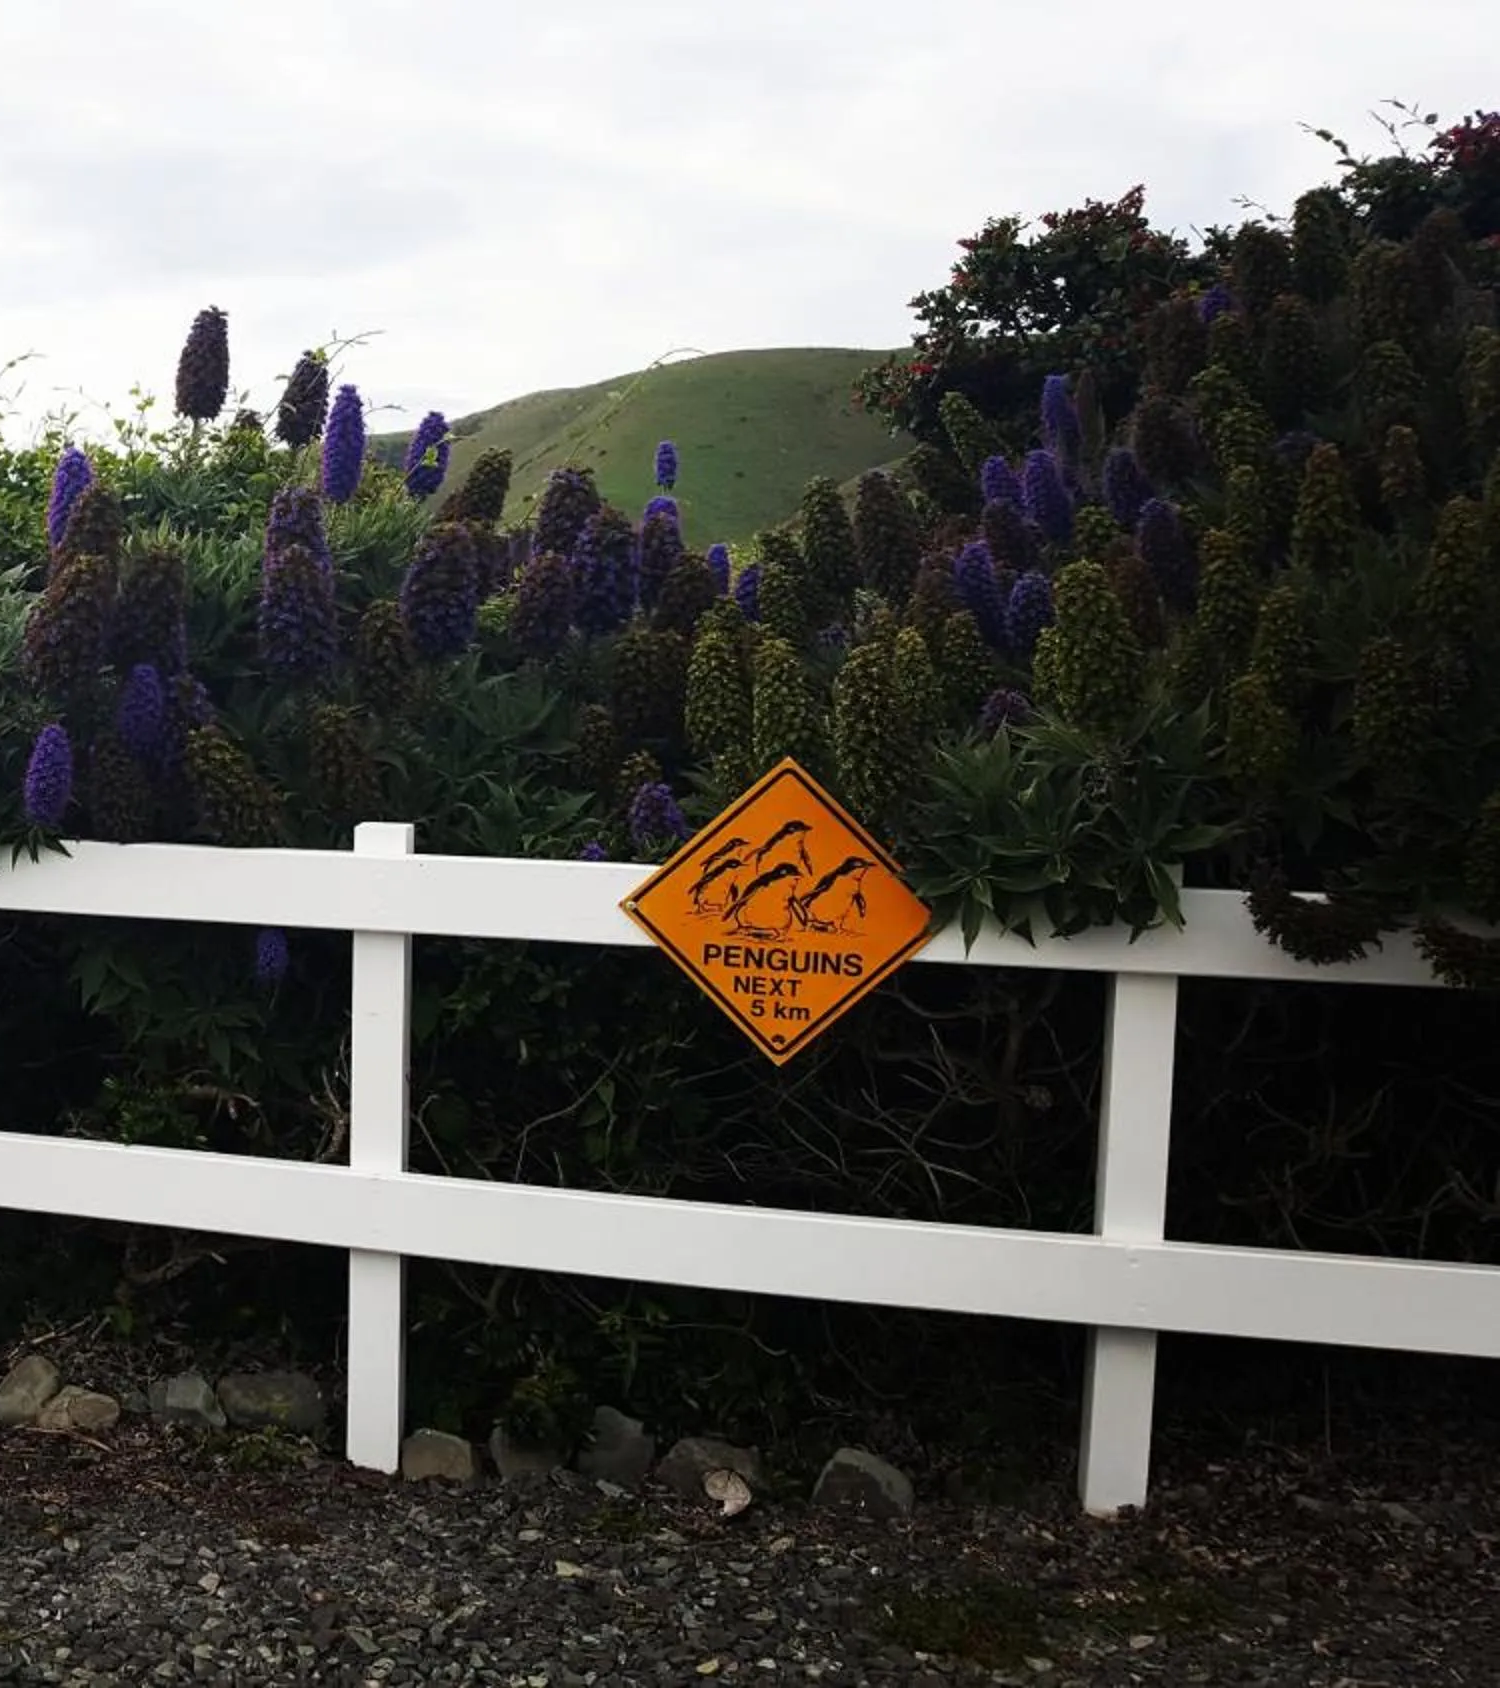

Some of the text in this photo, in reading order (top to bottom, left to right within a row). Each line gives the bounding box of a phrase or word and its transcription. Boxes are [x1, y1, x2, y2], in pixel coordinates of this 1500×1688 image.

[703, 943, 864, 977] PENGUINS
[733, 976, 802, 997] NEXT
[750, 1000, 810, 1021] 5 km
